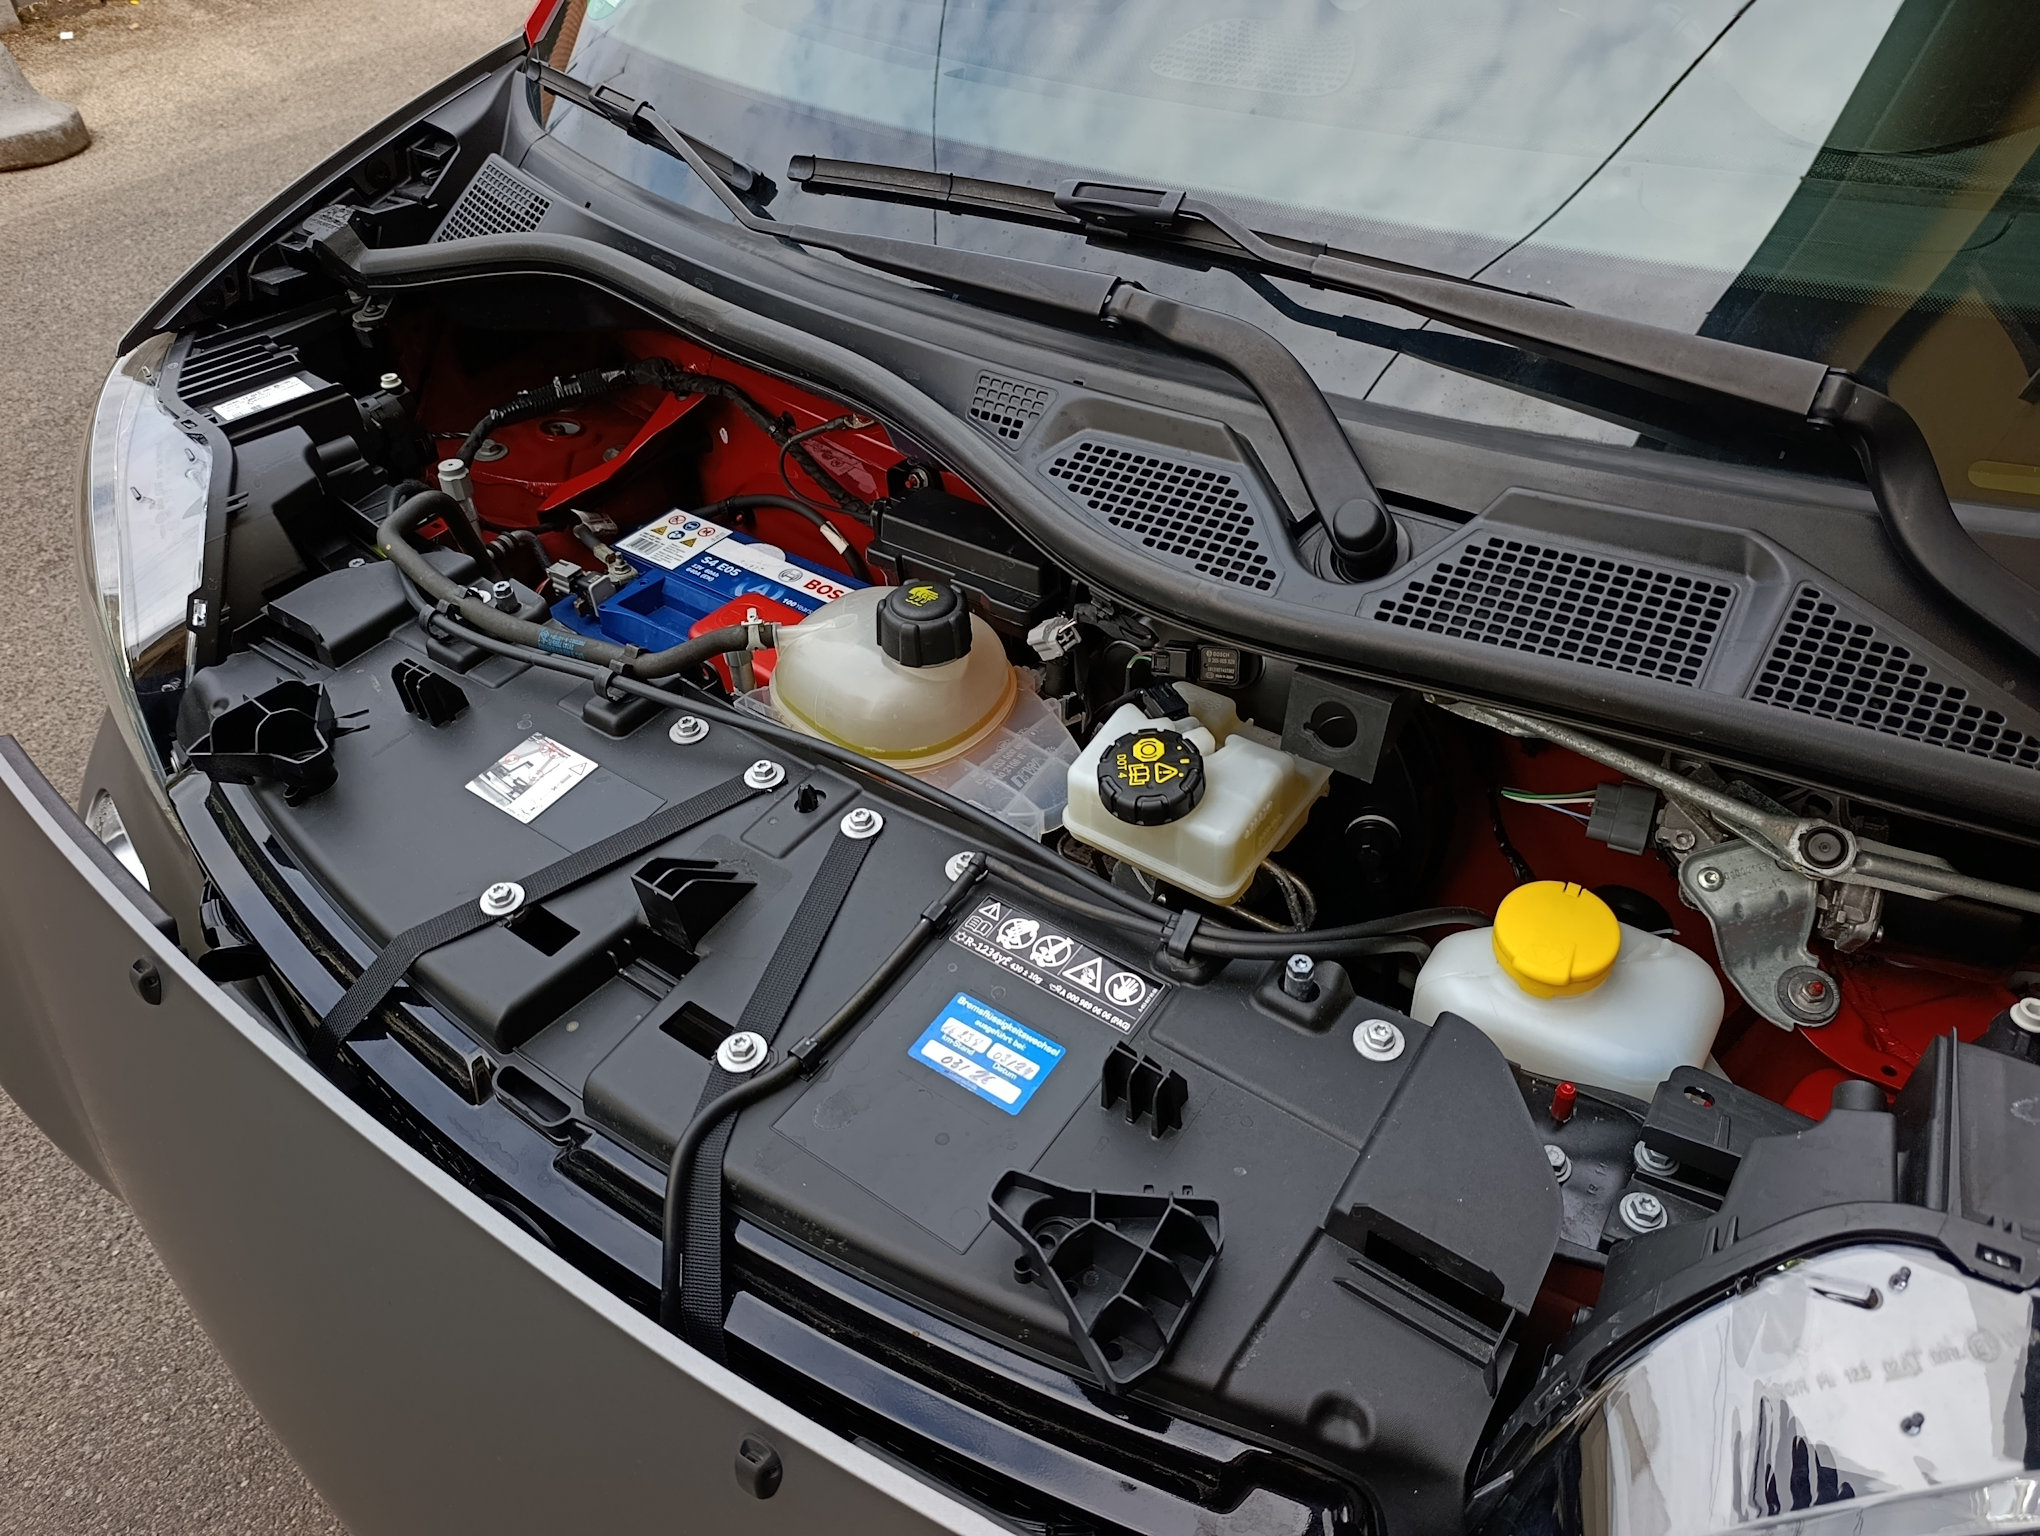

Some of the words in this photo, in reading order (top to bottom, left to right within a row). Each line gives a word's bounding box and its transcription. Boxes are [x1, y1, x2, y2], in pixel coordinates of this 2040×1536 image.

[685, 567, 701, 577] 640A
[691, 563, 704, 571] 12V
[704, 568, 720, 578] 60Ah
[701, 556, 719, 567] S4
[716, 562, 742, 576] E05
[803, 578, 845, 600] BOS
[781, 597, 797, 607] 100
[796, 602, 814, 614] Years
[1116, 753, 1128, 771] DOT
[963, 936, 1013, 966] R-1234yf
[1009, 962, 1024, 974] 430
[1027, 972, 1044, 985] 10g
[1065, 991, 1080, 1003] 000
[1078, 999, 1093, 1010] 989
[1091, 1006, 1102, 1016] 06
[1101, 1011, 1112, 1021] 06
[1110, 1015, 1131, 1031] (PAG)
[957, 995, 1061, 1057] Bremsflüssigkeitswechsel
[974, 1019, 1014, 1044] ausgeführt
[1011, 1038, 1026, 1051] bei:
[941, 1034, 976, 1056] km-Stand
[992, 1061, 1018, 1080] Datum
